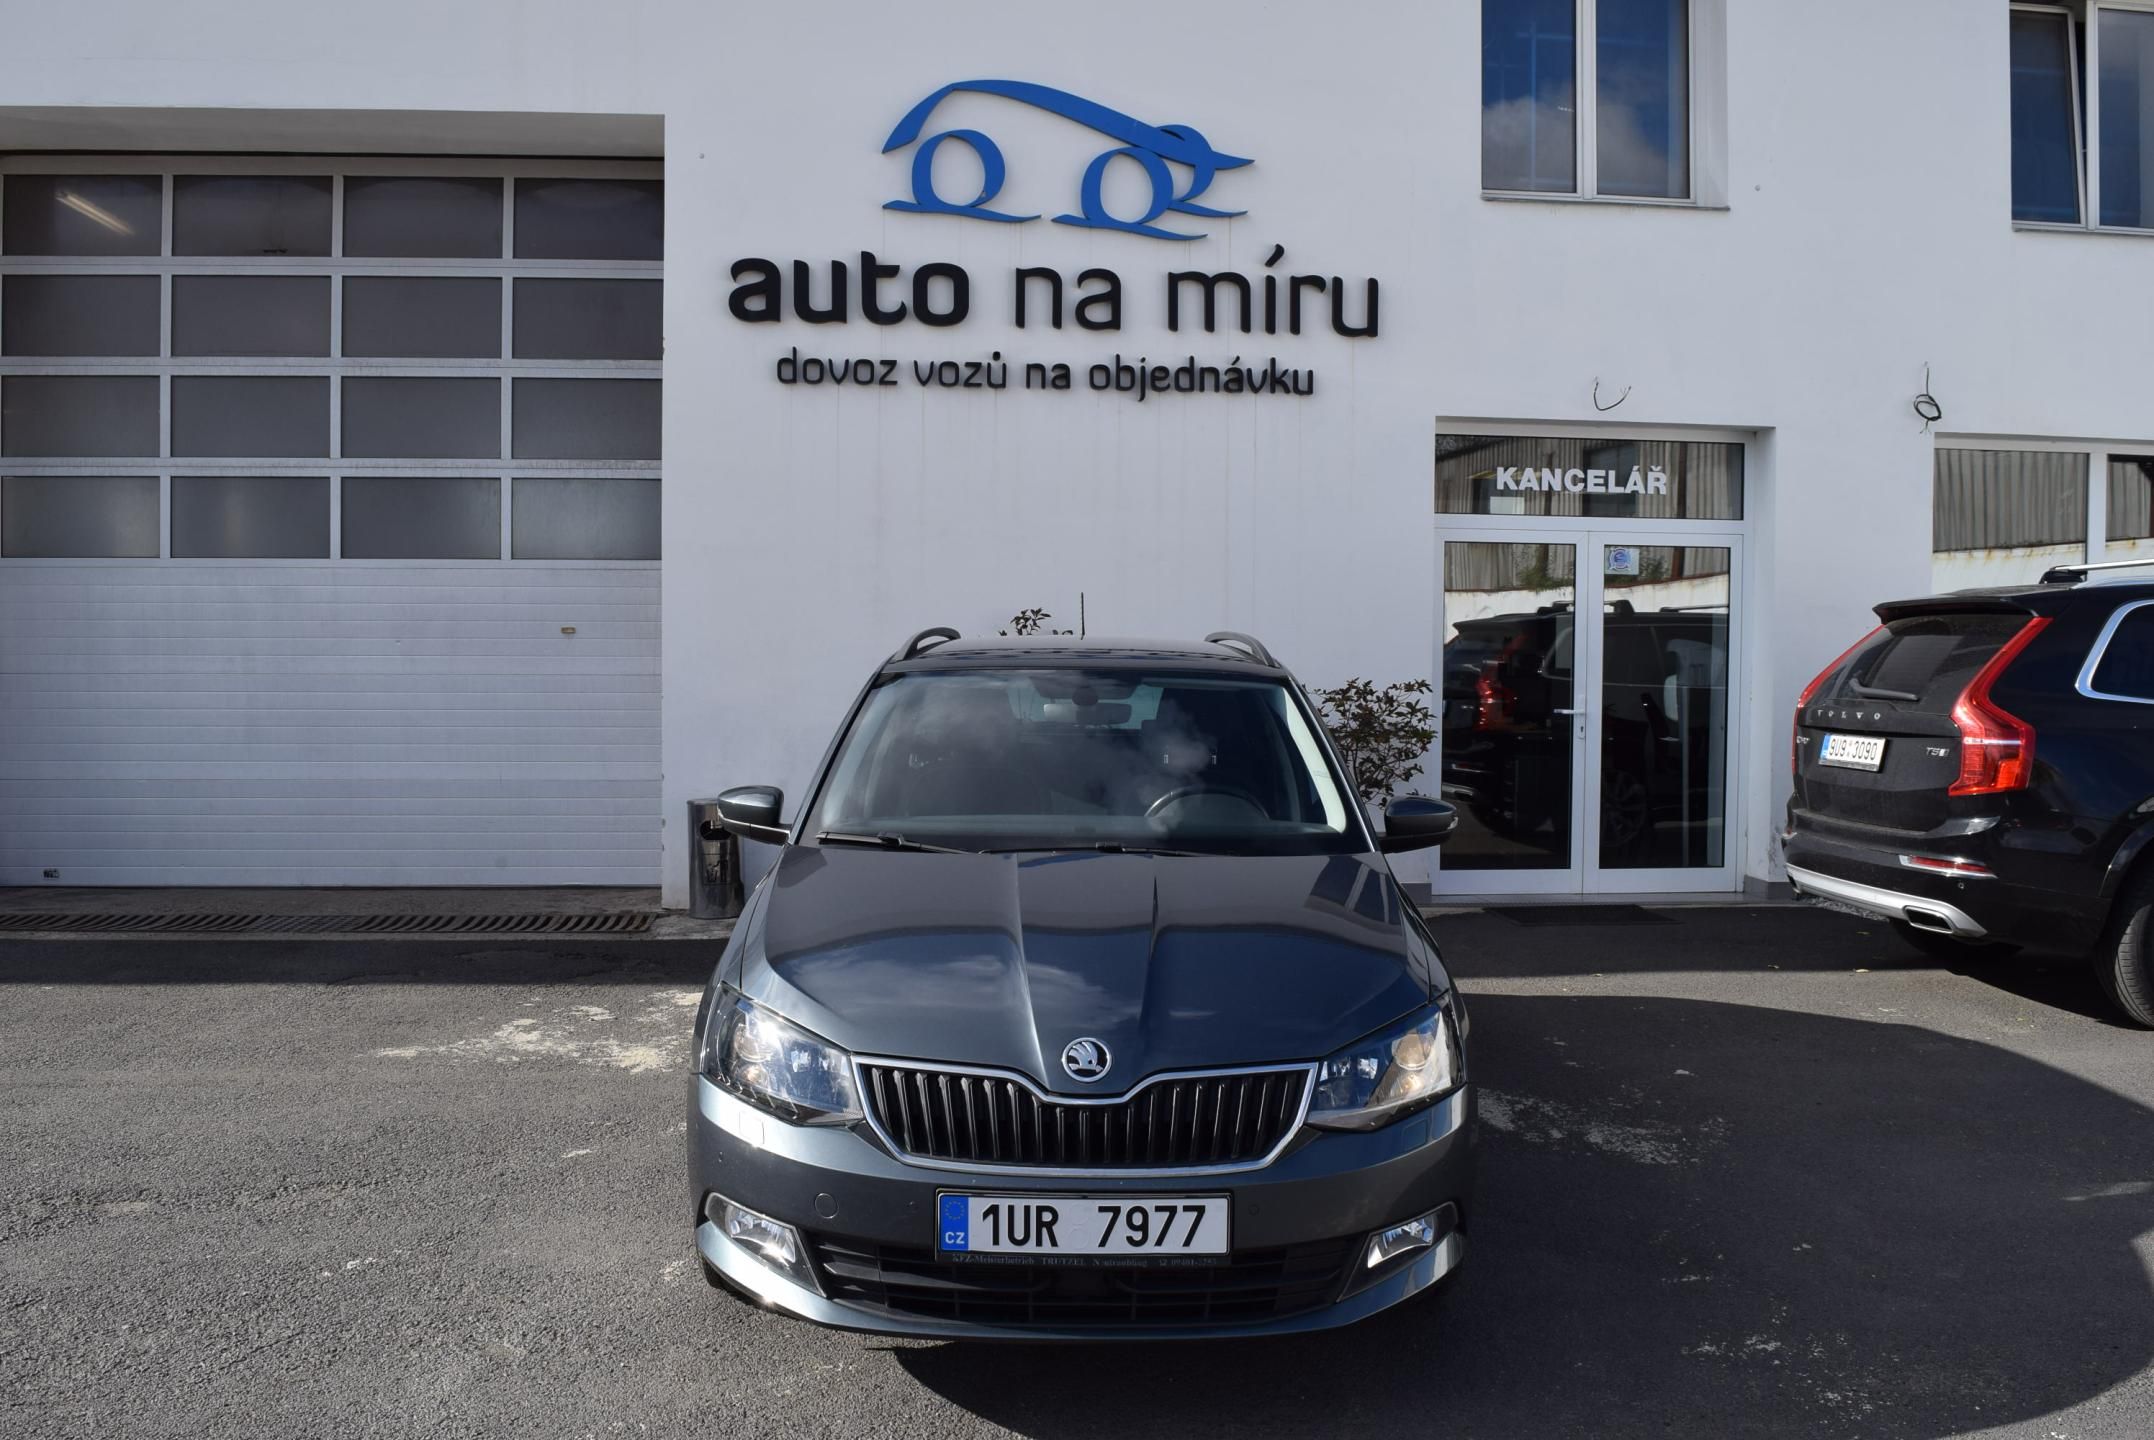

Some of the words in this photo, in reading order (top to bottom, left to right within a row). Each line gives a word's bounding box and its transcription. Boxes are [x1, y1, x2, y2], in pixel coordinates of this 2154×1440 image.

[729, 251, 970, 327] auto
[1015, 266, 1121, 331] na
[1168, 244, 1379, 338] míru
[776, 347, 898, 387] dovoz
[914, 350, 1007, 390] vozů
[1026, 362, 1071, 390] na
[1089, 354, 1313, 402] objednávku
[1496, 465, 1667, 495] KANCELÁŘ
[1817, 709, 1881, 721] VOLVO
[1829, 738, 1848, 757] 9U9
[1852, 740, 1878, 761] 3090
[945, 1232, 965, 1244] CZ
[982, 1204, 1059, 1247] 1UR
[1098, 1205, 1206, 1248] 7977
